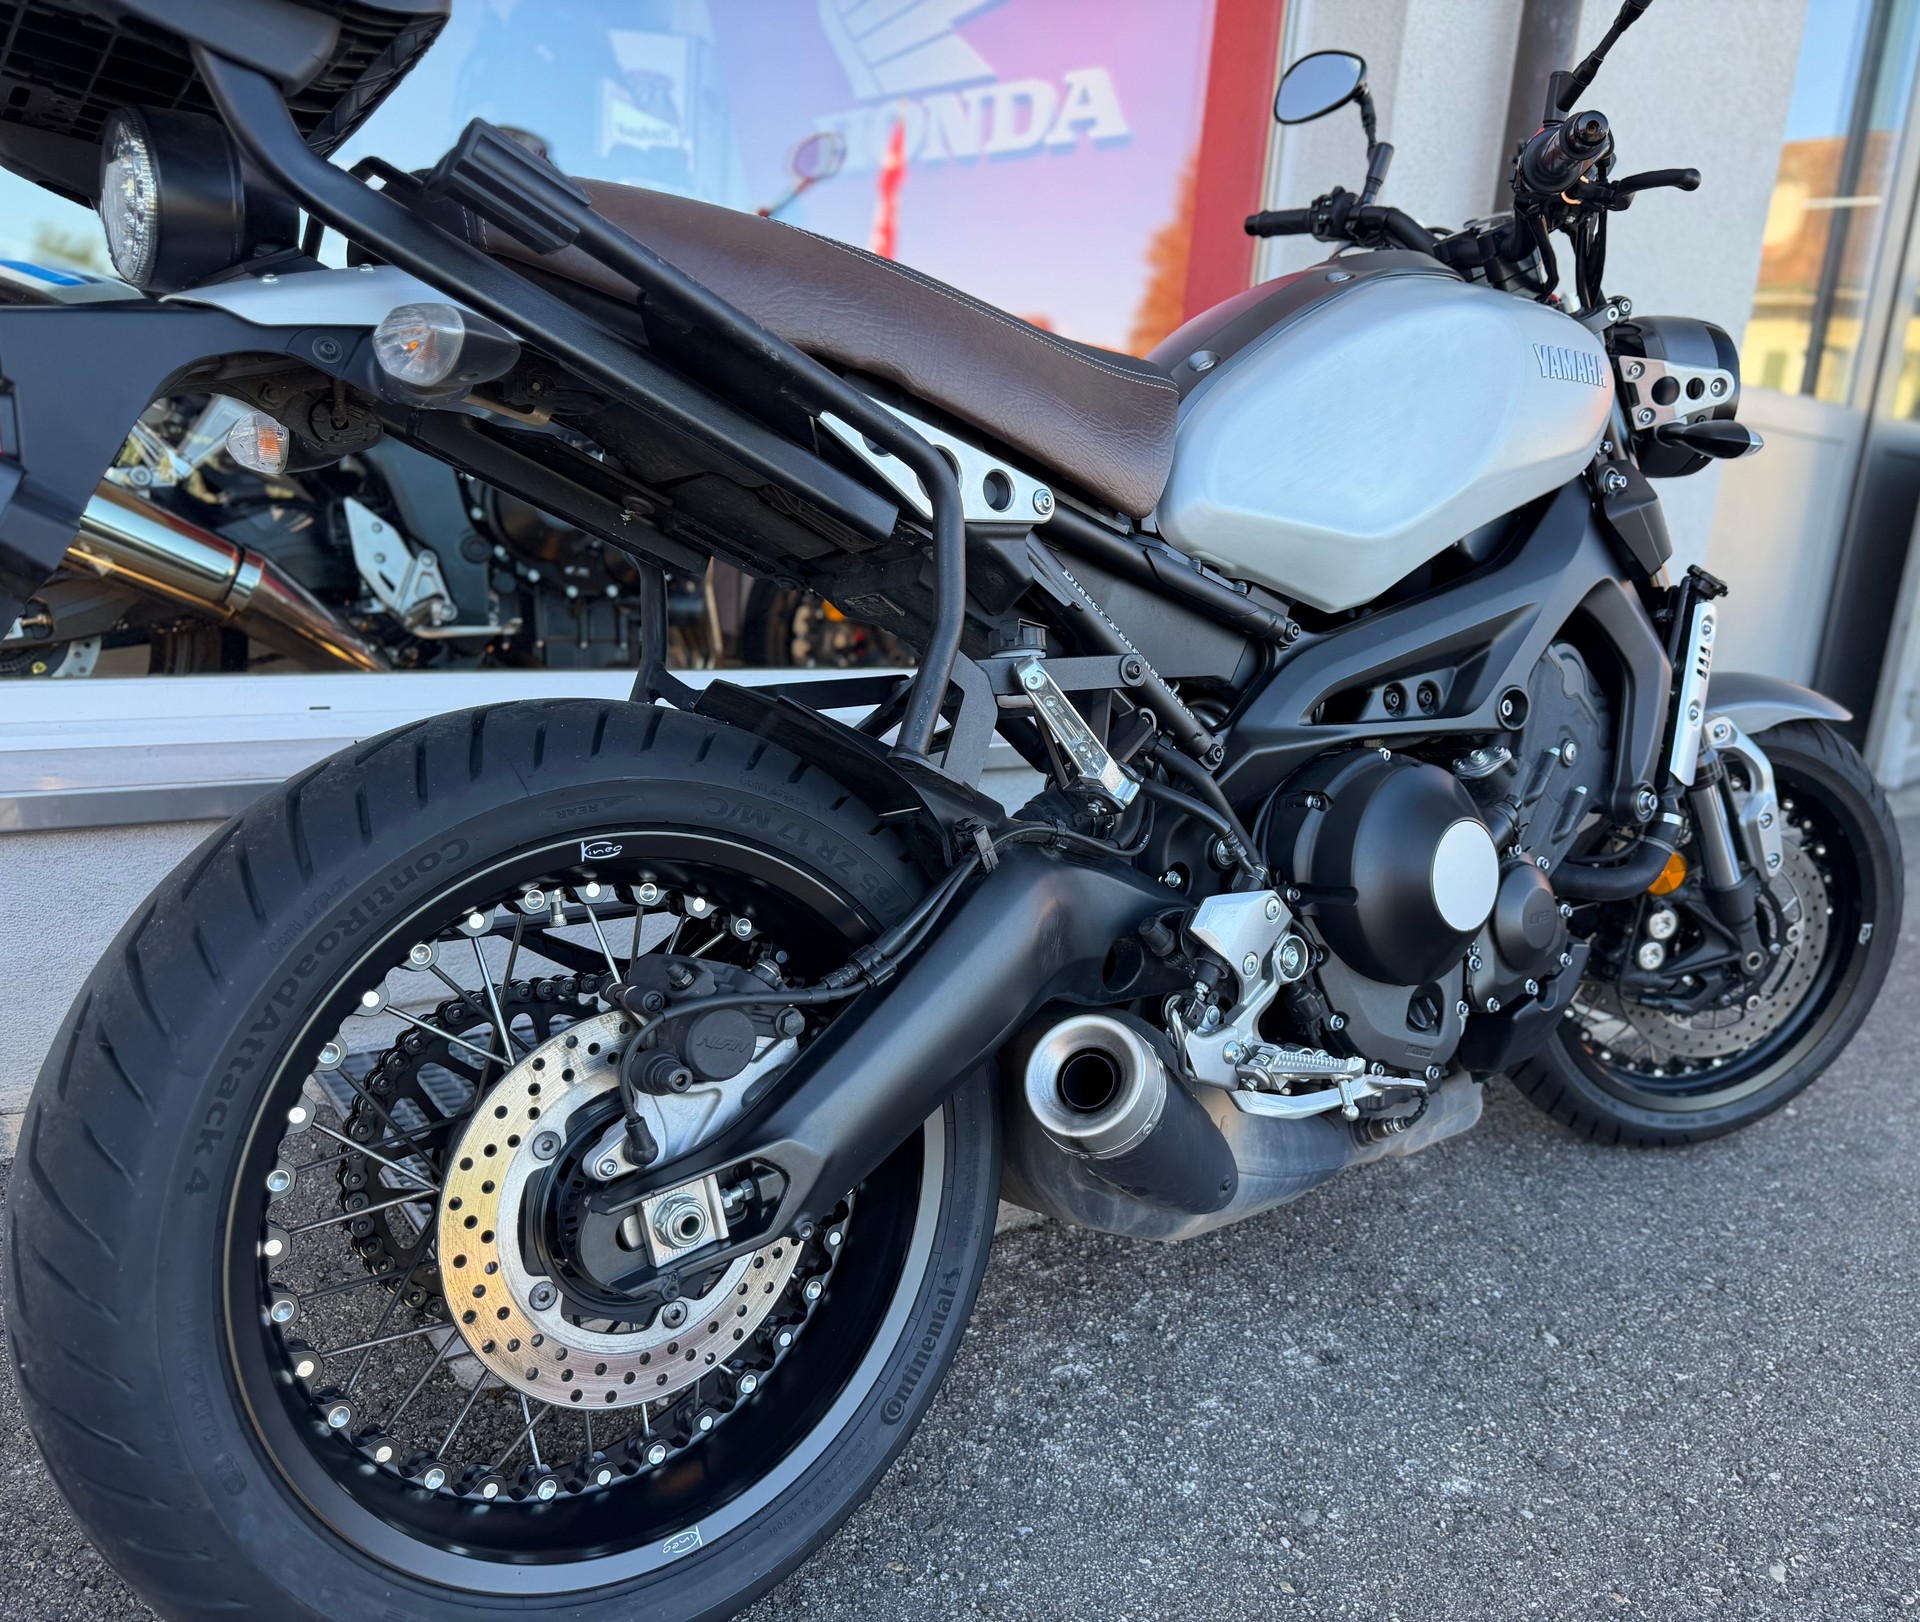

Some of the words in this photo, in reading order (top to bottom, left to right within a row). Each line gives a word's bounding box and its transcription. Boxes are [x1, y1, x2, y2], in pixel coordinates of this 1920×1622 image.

[1532, 343, 1607, 388] YAMAHA
[556, 803, 599, 820] REAR
[704, 798, 773, 830] M/C
[776, 821, 810, 849] 17
[580, 841, 623, 862] Kineo
[816, 838, 857, 876] ZR
[193, 837, 471, 1157] ContiRoadAttack
[183, 1167, 210, 1196] 4
[879, 1286, 957, 1426] Continental
[662, 1525, 703, 1554] Kineo
